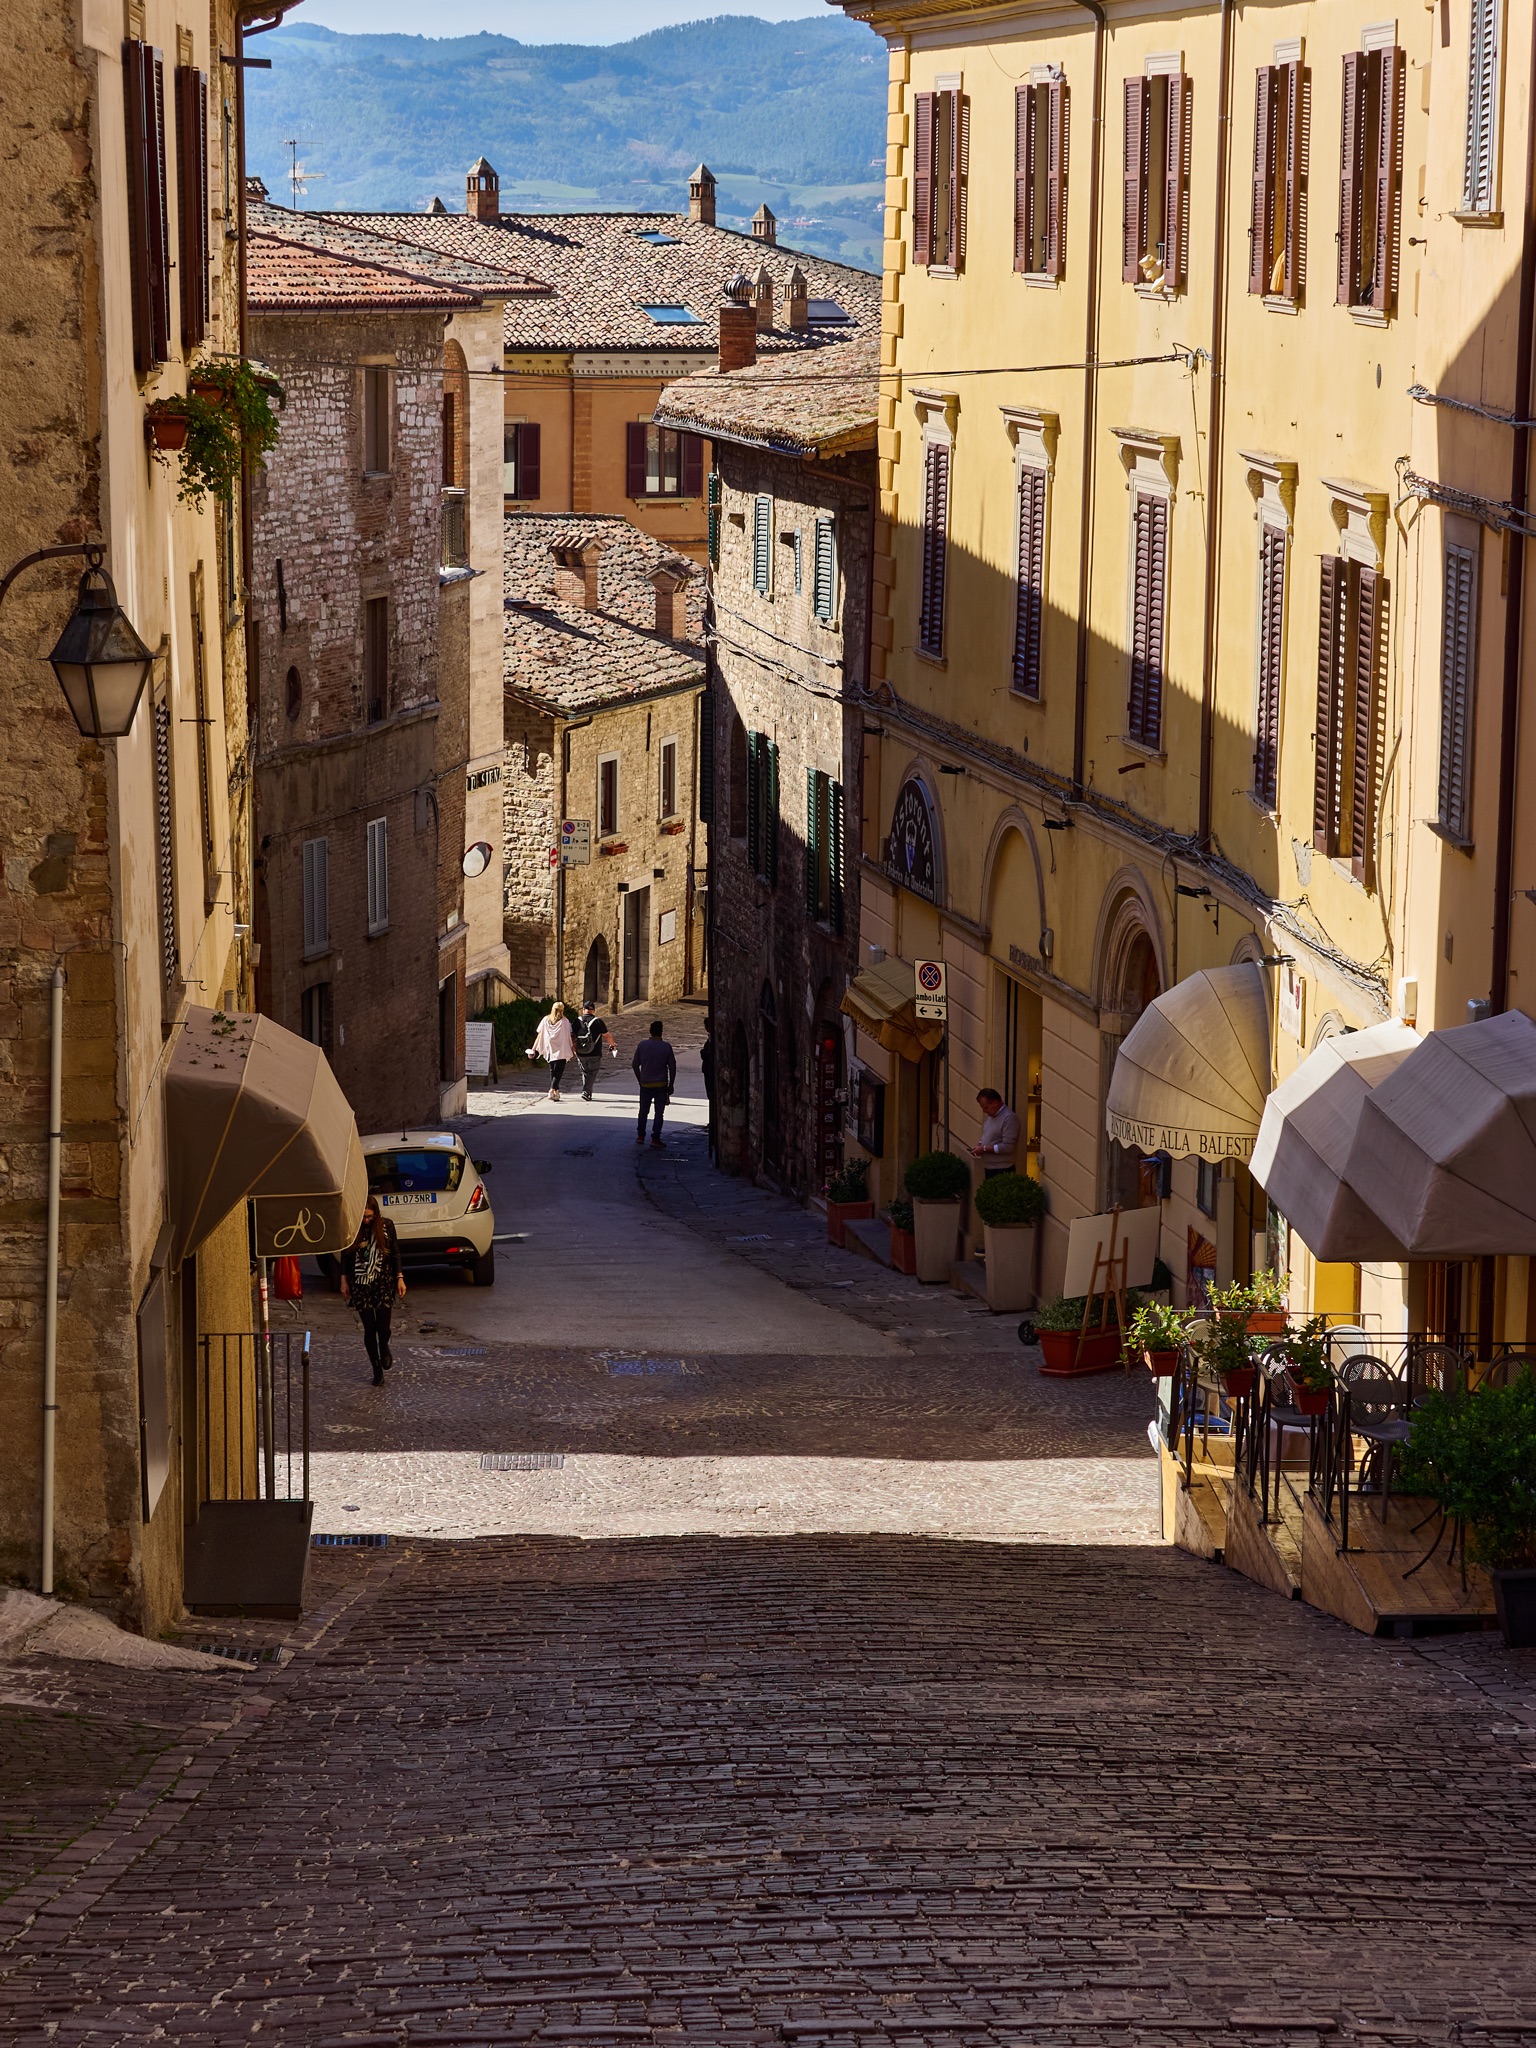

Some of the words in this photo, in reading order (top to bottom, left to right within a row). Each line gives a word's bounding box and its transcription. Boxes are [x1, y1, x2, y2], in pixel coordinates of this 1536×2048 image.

[889, 788, 933, 879] Ristorante
[916, 992, 932, 1001] ambo
[935, 994, 946, 1003] lati
[1110, 1115, 1155, 1147] RISTORANTE
[1159, 1129, 1191, 1152] ALLA
[388, 1195, 400, 1205] GA
[402, 1193, 431, 1204] 073NR
